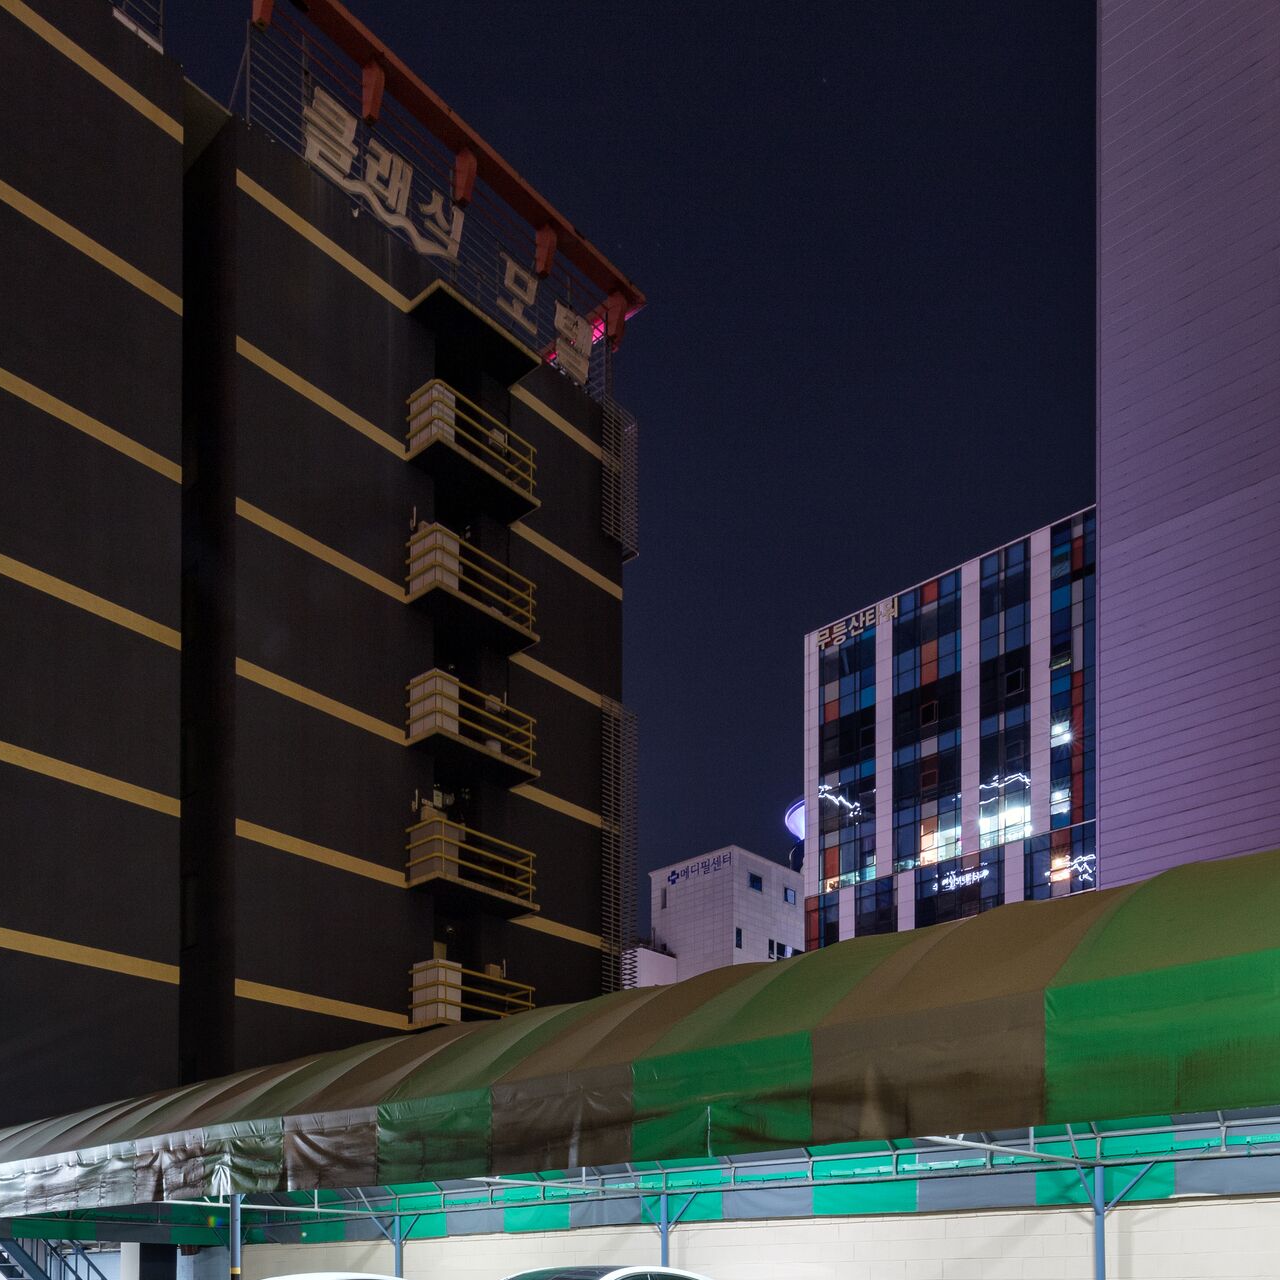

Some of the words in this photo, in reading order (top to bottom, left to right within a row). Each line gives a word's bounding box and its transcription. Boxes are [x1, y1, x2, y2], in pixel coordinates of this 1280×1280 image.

[303, 86, 465, 262] 클래식
[498, 251, 593, 385] 모텔
[816, 597, 898, 650] 무등산타워
[680, 852, 732, 880] 메디필센터
